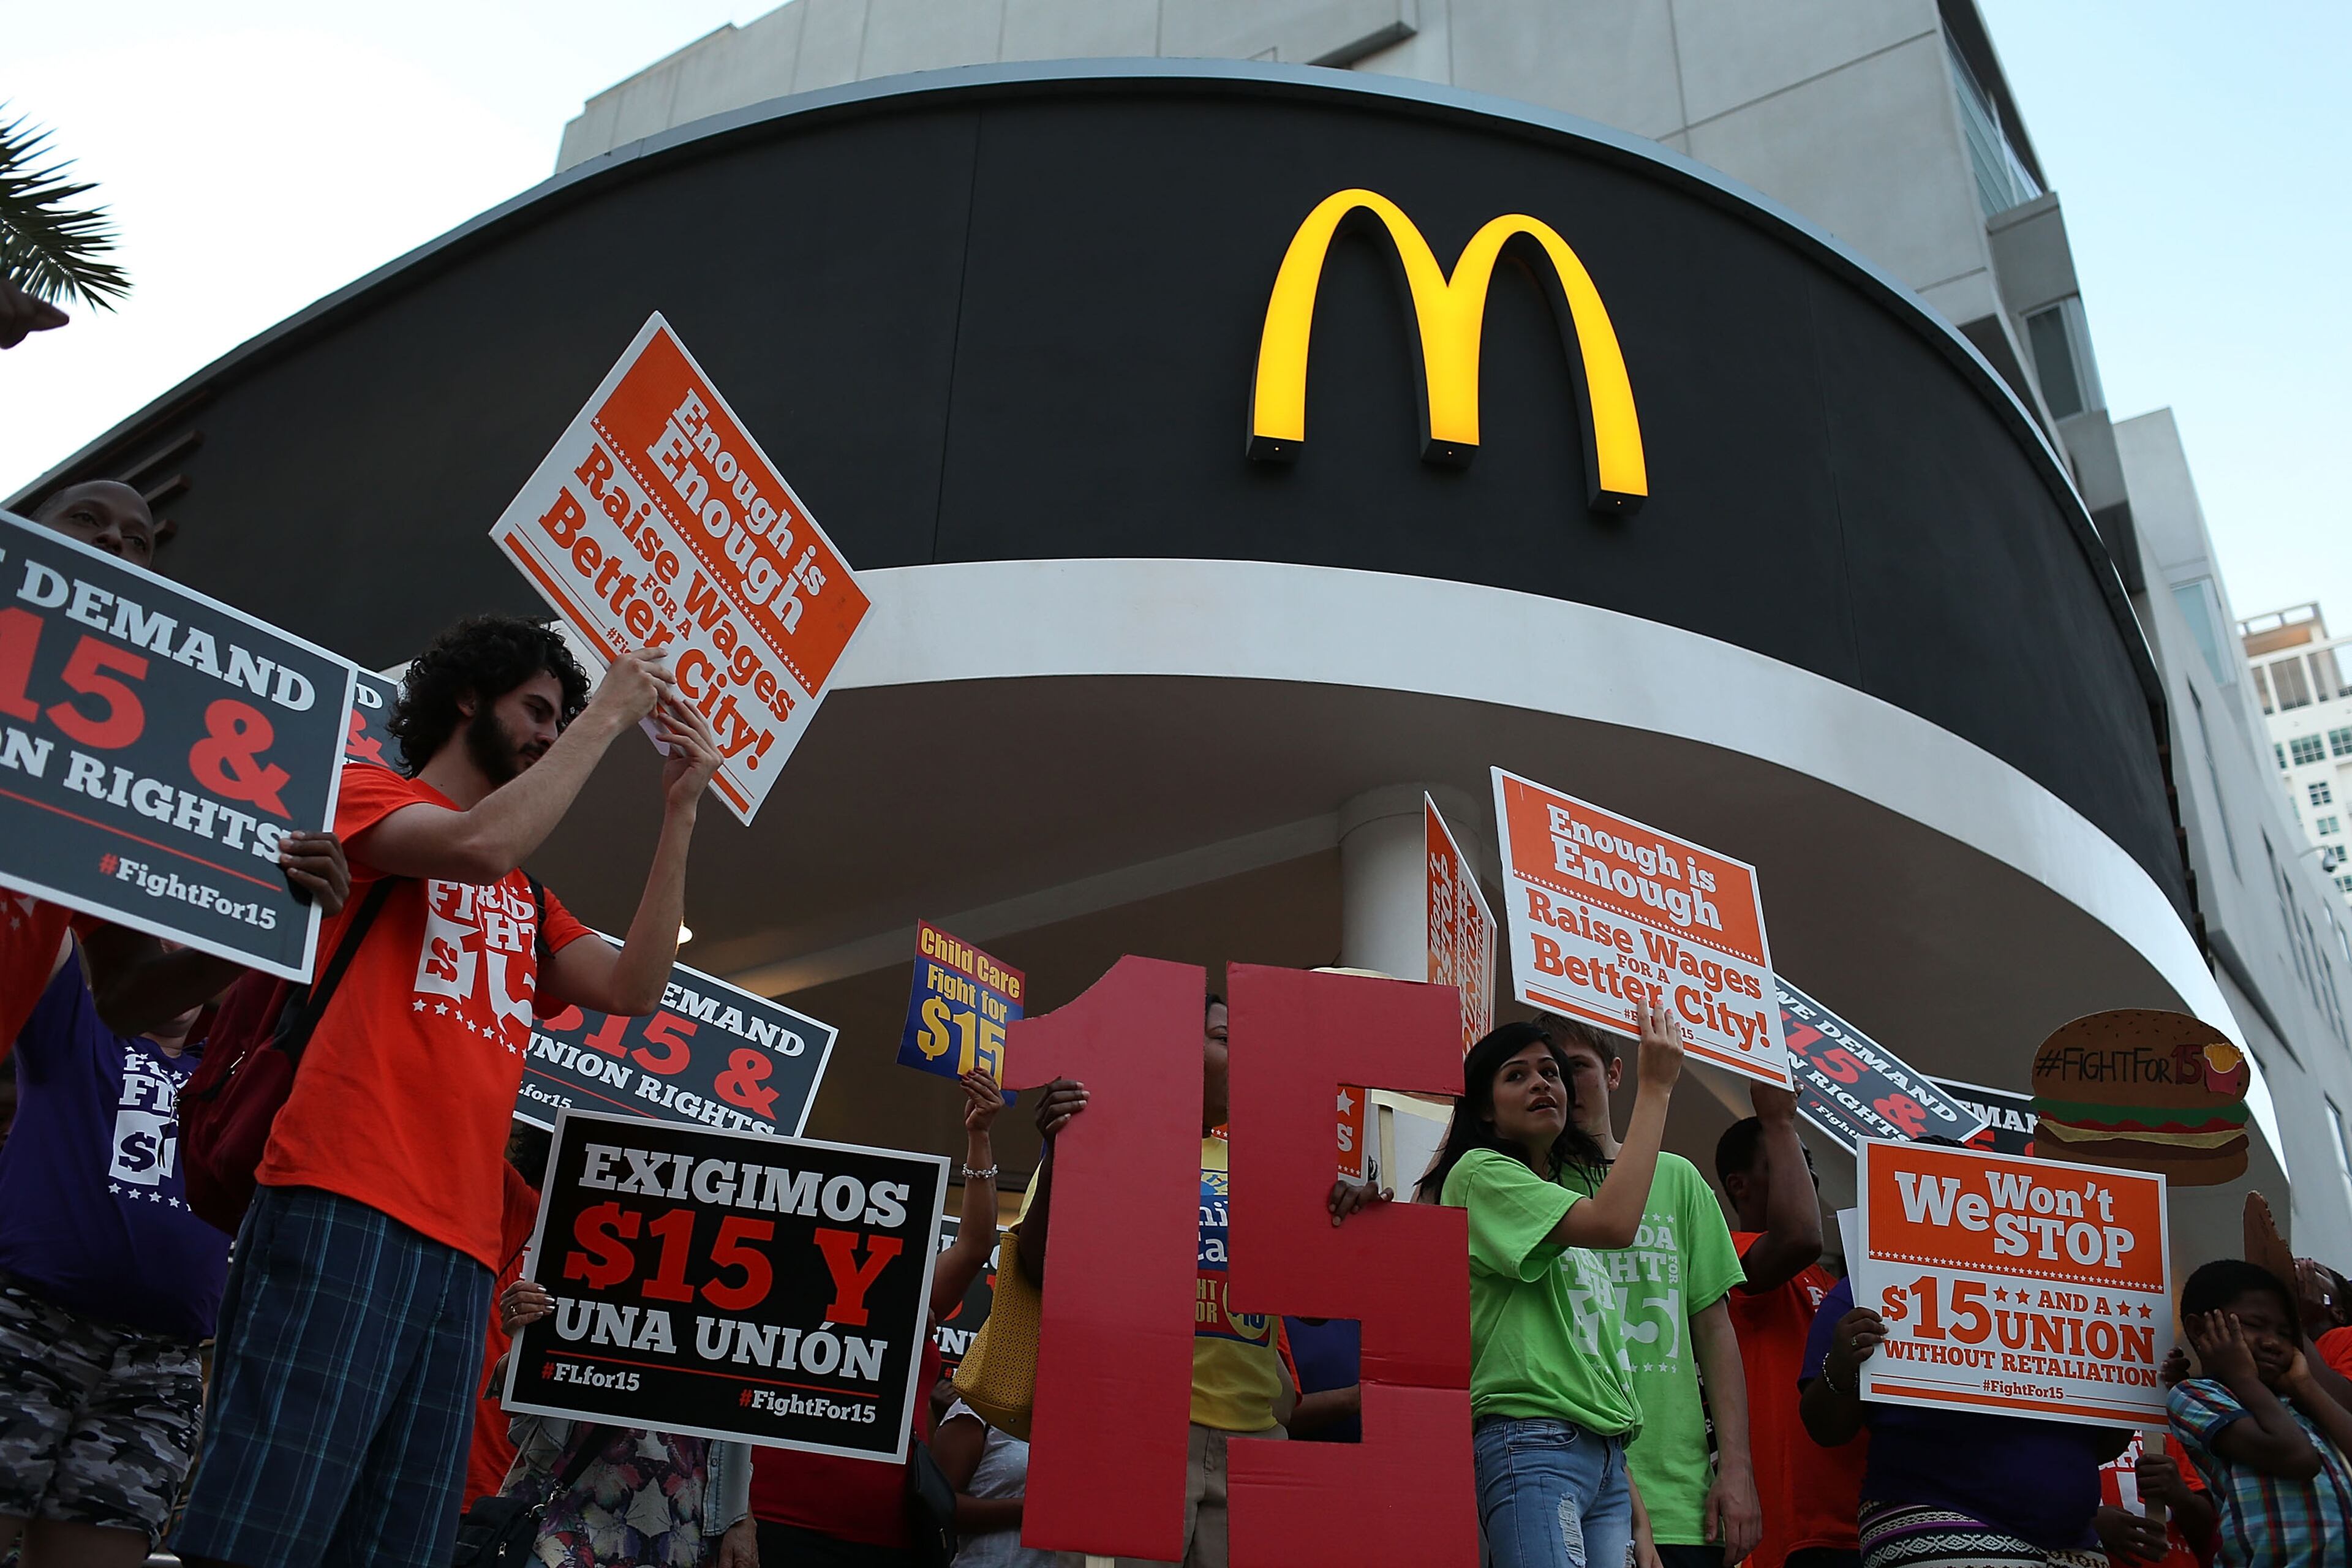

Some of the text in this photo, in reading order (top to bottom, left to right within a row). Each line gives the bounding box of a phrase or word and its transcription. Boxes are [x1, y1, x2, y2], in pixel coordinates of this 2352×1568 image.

[646, 417, 807, 635] Enough
[672, 388, 826, 596] Enough is
[573, 442, 796, 723] Raise Wages
[641, 573, 692, 641] FOR A
[17, 559, 316, 712] DEMAND
[538, 486, 775, 771] Better City!
[189, 698, 293, 820] &
[63, 750, 292, 864] RIGHTS
[1546, 802, 1717, 893] Enough is
[99, 852, 277, 931] #FightFor15
[1550, 834, 1723, 932] Enough
[921, 927, 1020, 999] Child Care
[1525, 886, 1763, 1000] Raise Wages
[1616, 953, 1671, 984] FOR A
[660, 982, 805, 1057] EMAND
[927, 963, 1008, 1024] Fight for
[1530, 931, 1663, 1009] Better
[1674, 984, 1771, 1052] City!
[714, 1048, 780, 1121] &
[916, 995, 1006, 1090] $15
[1781, 1009, 1928, 1139] 15 &
[1814, 1019, 1958, 1123] DEMAND
[1809, 1100, 1861, 1139] #Fight
[578, 1142, 911, 1227] EXIGIMOS
[1894, 1170, 2114, 1232] We Won't
[562, 1200, 904, 1327] $15 Y
[1993, 1212, 2136, 1270] STOP
[554, 1297, 677, 1354] UNA
[695, 1321, 889, 1382] UNIÓN
[1881, 1275, 2112, 1345] $15 AND A
[1994, 1308, 2156, 1365] UNION
[540, 1362, 876, 1425] #FLfor15 #FightFor15
[1883, 1340, 2157, 1389] WITHOUT RETALIATION
[1982, 1379, 2065, 1400] #FightFor15
